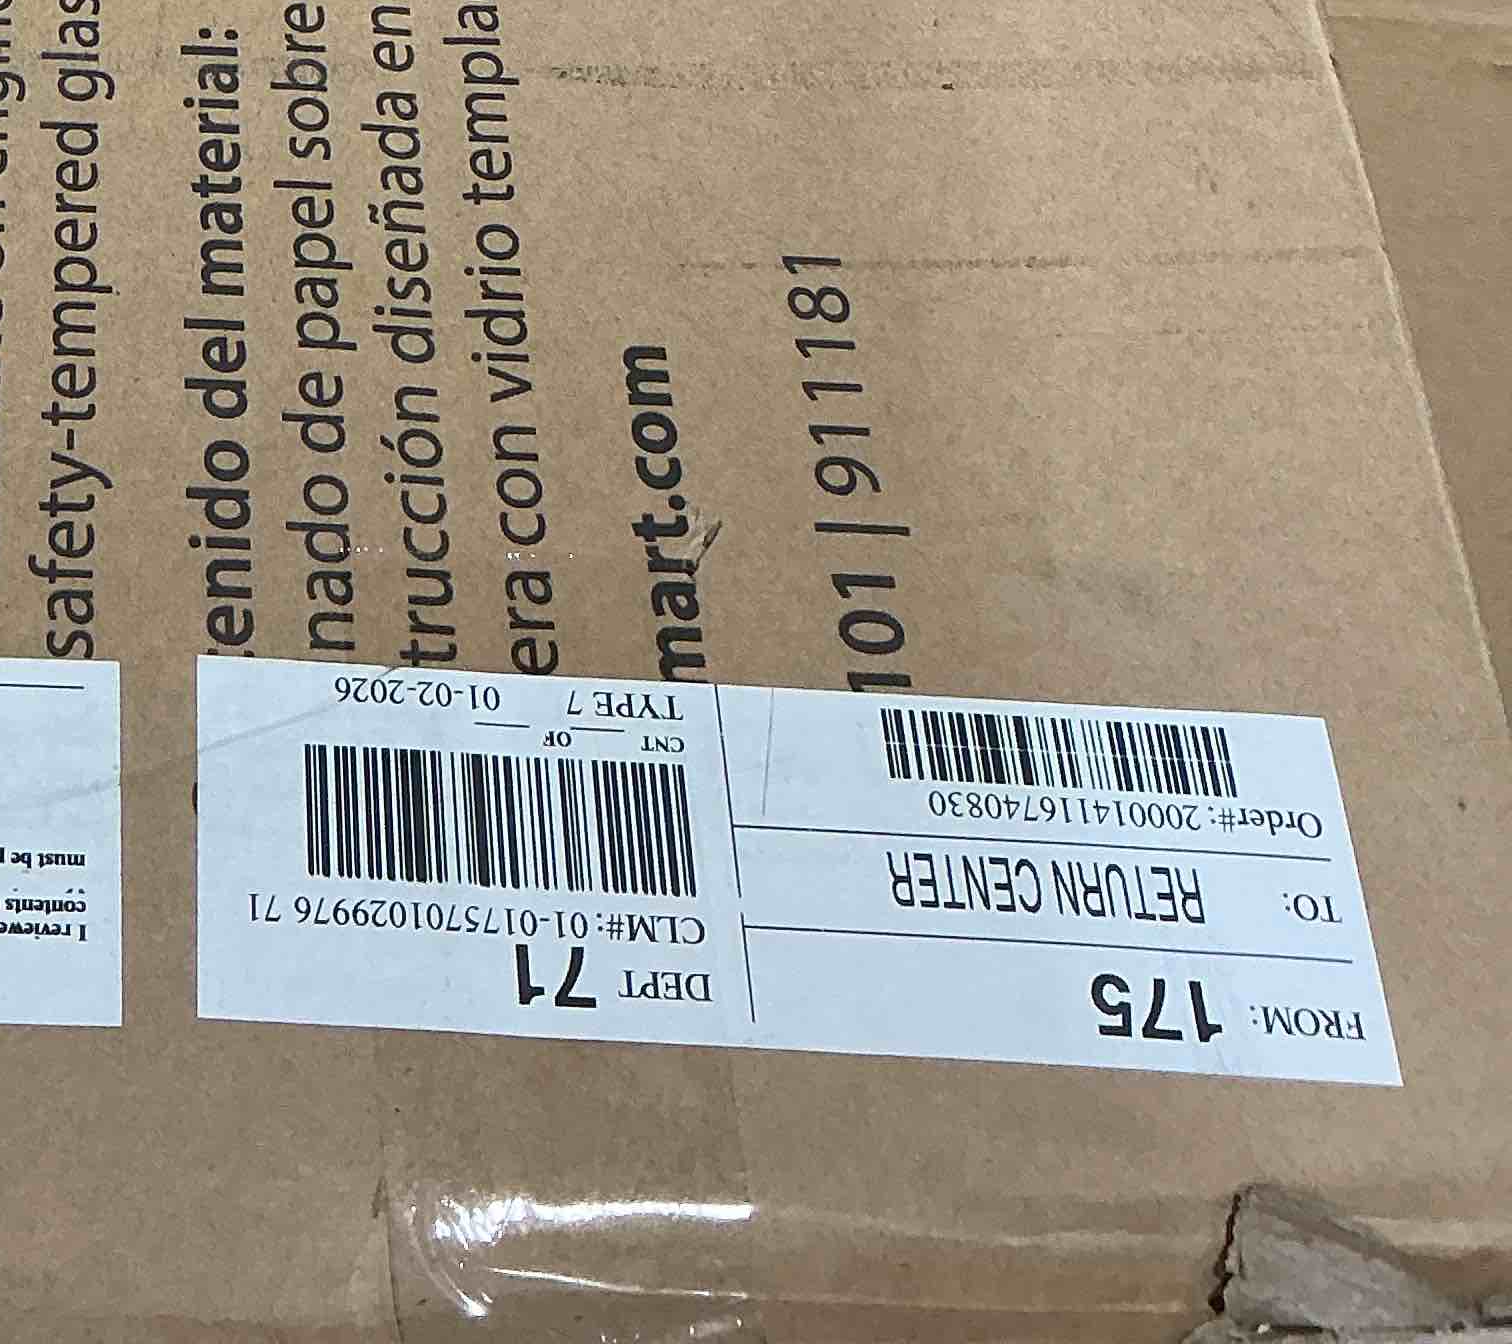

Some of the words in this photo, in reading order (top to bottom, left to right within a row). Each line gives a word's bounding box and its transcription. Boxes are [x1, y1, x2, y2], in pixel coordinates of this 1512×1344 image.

[371, 6, 414, 72] en
[270, 3, 331, 160] sobre
[181, 28, 244, 296] material:
[361, 92, 435, 363] diseñada
[273, 181, 357, 351] papel
[464, 224, 532, 402] vidrio
[184, 317, 247, 419] del
[28, 121, 113, 658] safety-tempered
[282, 371, 345, 453] de
[493, 426, 546, 546] con
[186, 440, 256, 657] enido
[334, 677, 500, 711] 01-02-2026
[567, 690, 580, 713] 7
[593, 691, 684, 720] TYPE
[543, 731, 572, 747] OF
[641, 735, 685, 753] CNT
[929, 790, 1199, 830] 200014116740830
[1210, 806, 1322, 839] Order#:
[10, 851, 32, 869] be
[37, 852, 86, 870] must
[887, 851, 1041, 912] CENTER
[1053, 862, 1205, 923] RETURN
[5, 897, 86, 915] contents
[248, 894, 280, 921] 71
[294, 895, 588, 937] 01-0175701029976
[1283, 889, 1343, 923] TO:
[79, 924, 86, 941] I
[597, 913, 706, 944] CLM#:
[516, 944, 597, 1008] 71
[618, 970, 712, 1002] DEPT
[1091, 973, 1222, 1042] 175
[1250, 1005, 1366, 1040] FROM:
